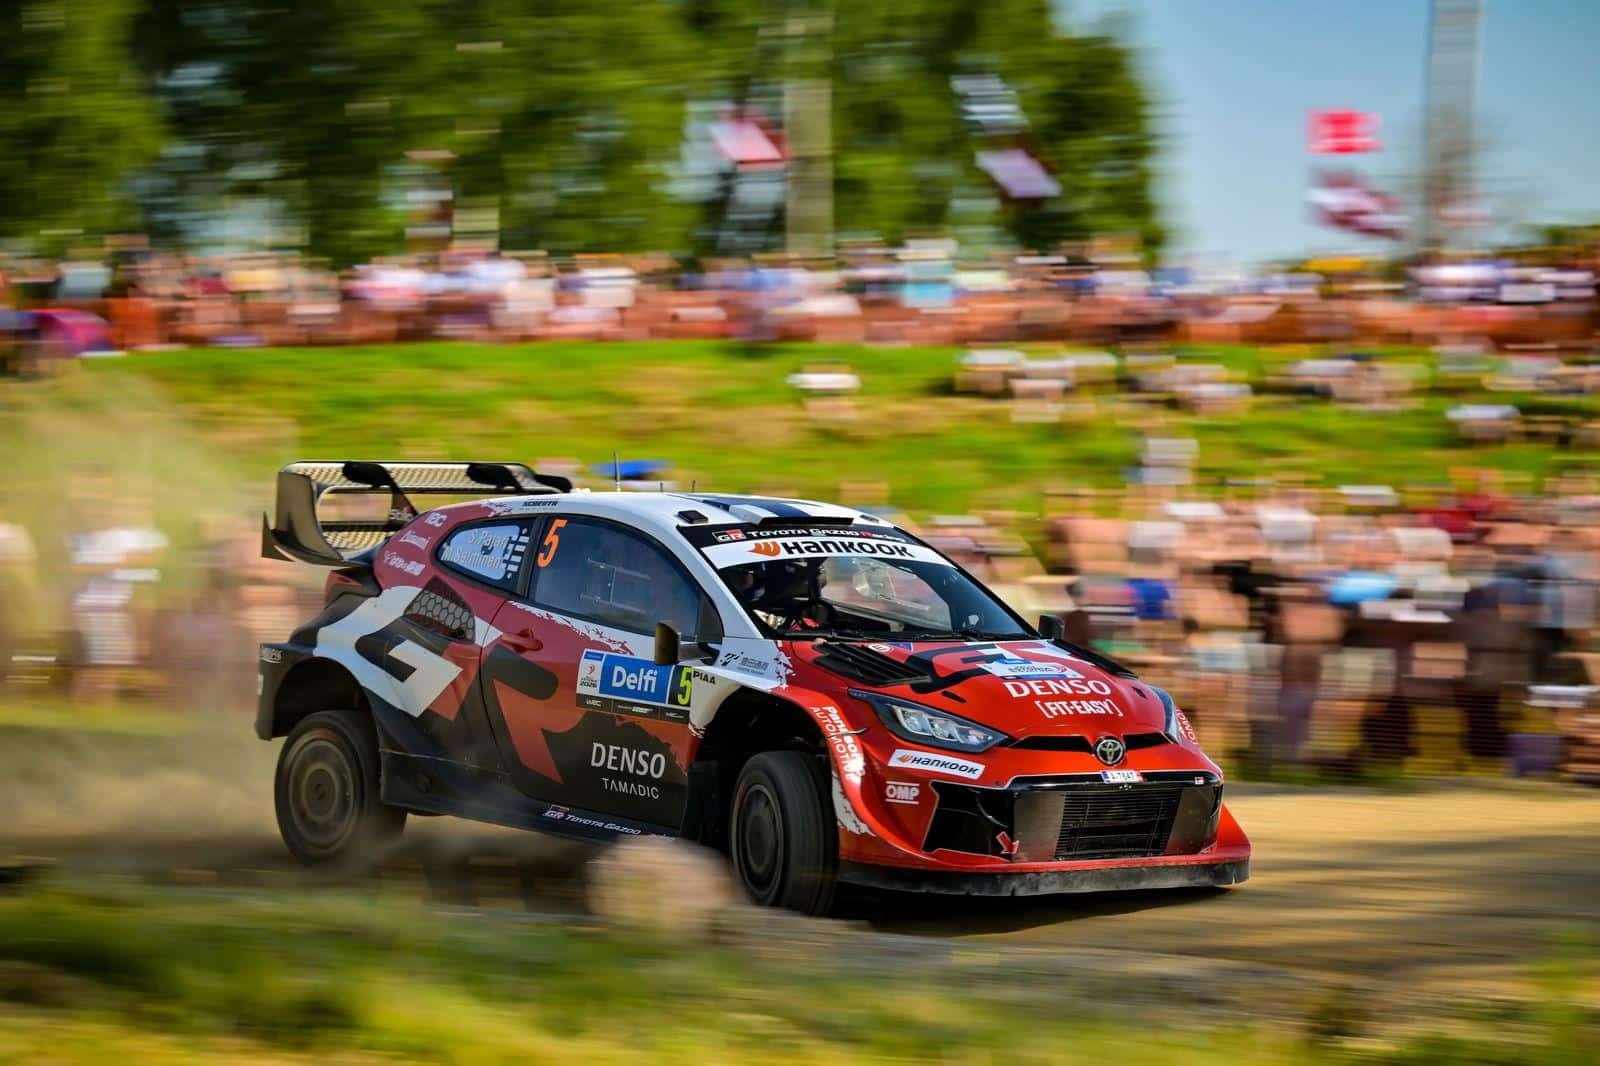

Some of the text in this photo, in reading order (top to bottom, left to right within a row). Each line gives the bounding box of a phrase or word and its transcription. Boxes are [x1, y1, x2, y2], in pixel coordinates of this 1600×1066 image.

[537, 518, 568, 569] 5
[717, 530, 746, 542] GR
[747, 529, 808, 538] TOYOTA
[810, 528, 860, 537] GAZOO
[611, 664, 658, 694] Delfi
[677, 667, 693, 706] 5
[693, 670, 716, 685] PIAA
[1004, 680, 1112, 698] DENSO
[590, 742, 666, 779] DENSO
[601, 777, 660, 800] TAMADIC
[886, 784, 920, 801] OMP
[565, 814, 604, 828] TOYOTA
[604, 823, 642, 835] GAZOO
